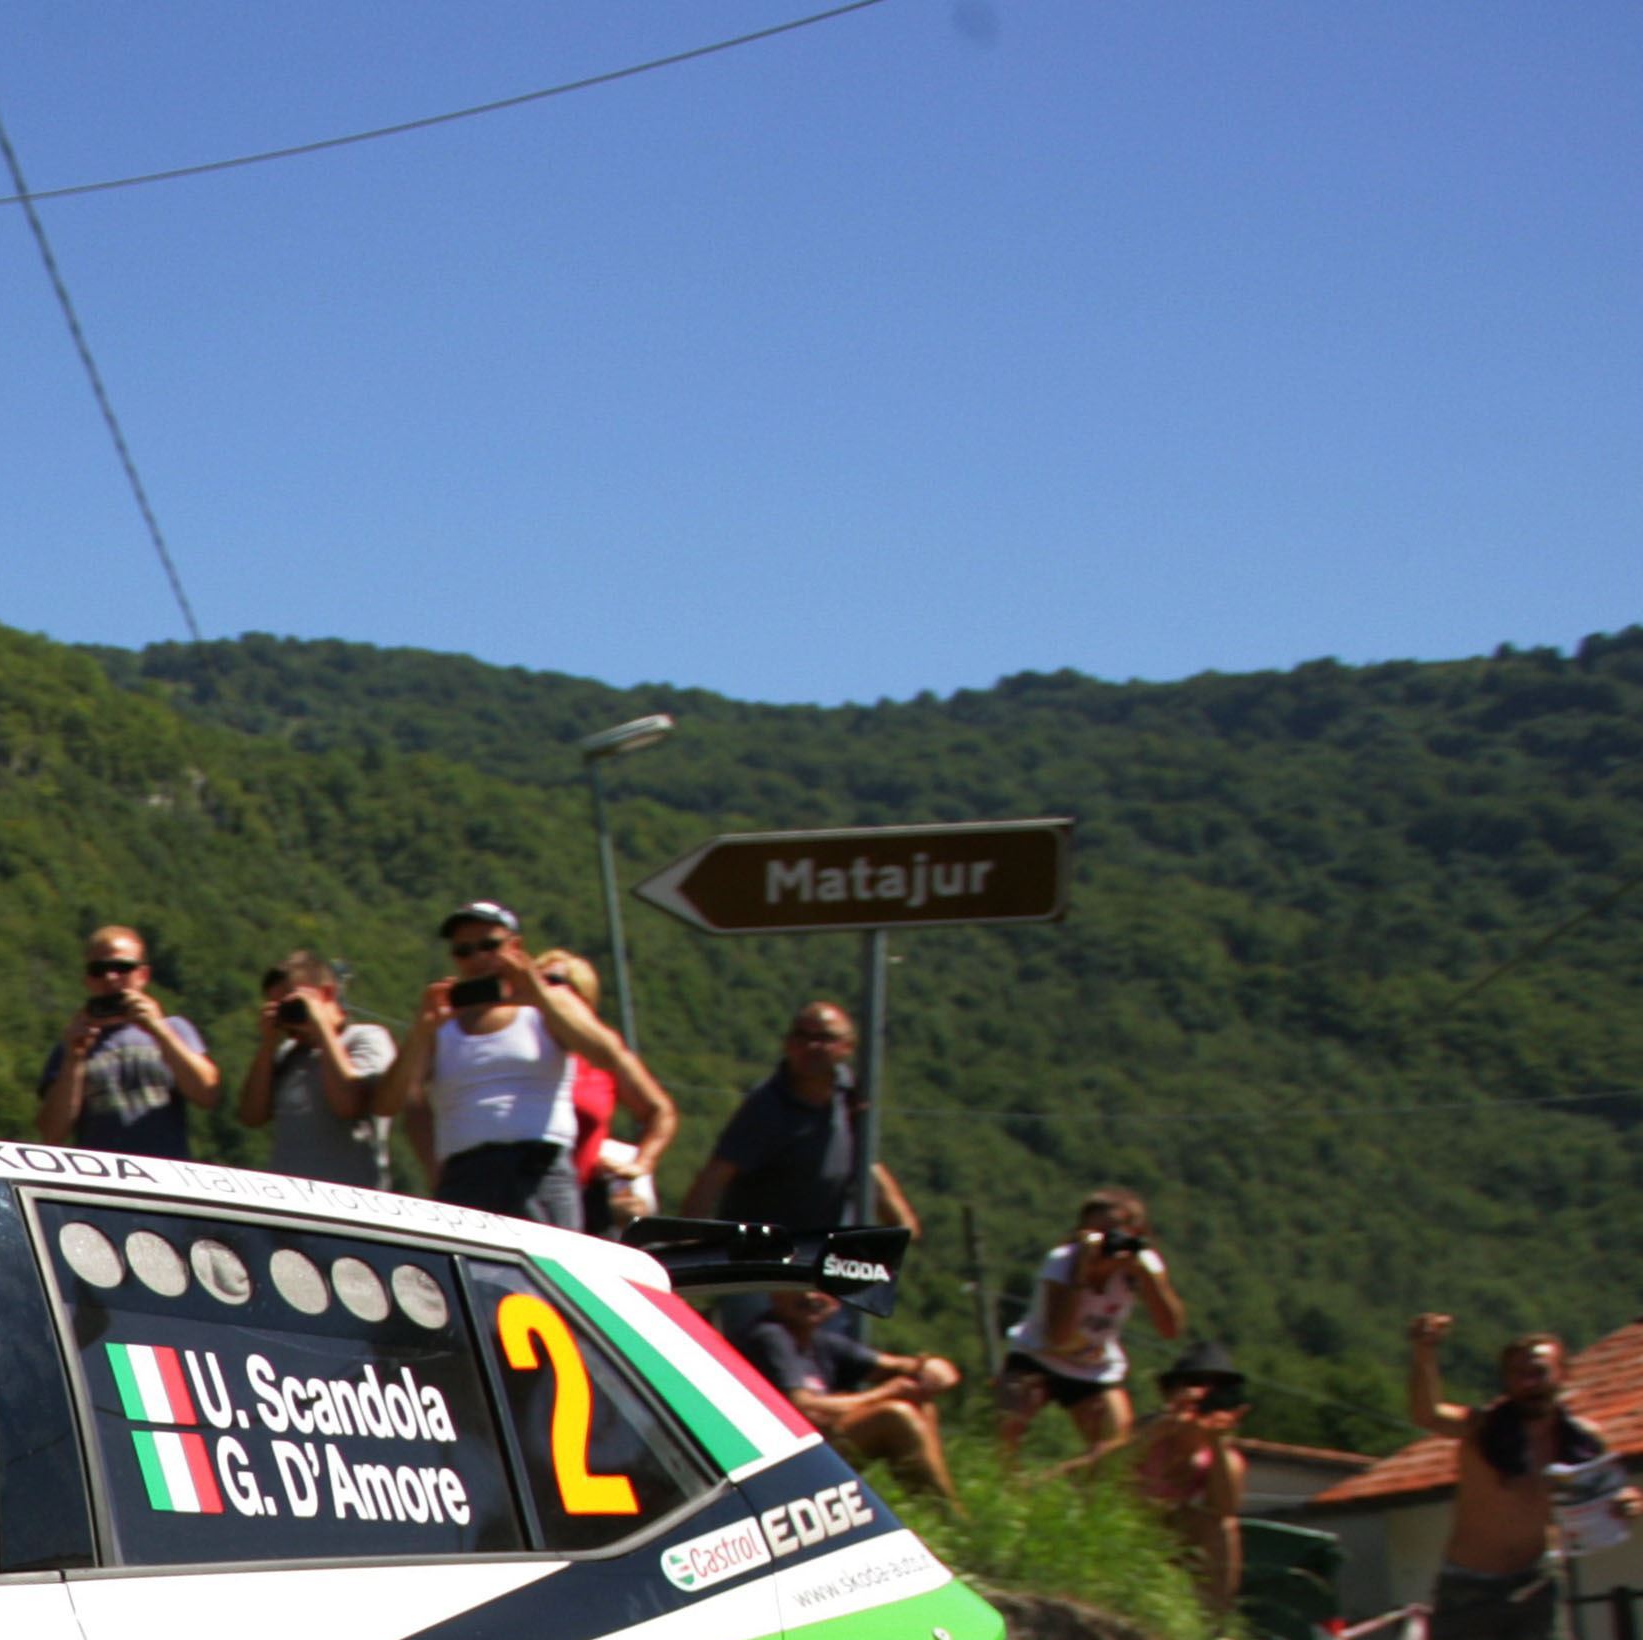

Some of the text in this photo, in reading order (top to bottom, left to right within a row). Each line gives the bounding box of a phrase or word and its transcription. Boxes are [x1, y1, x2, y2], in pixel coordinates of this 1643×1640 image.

[765, 853, 995, 908] Matajur
[169, 1161, 286, 1199] Italia
[822, 1250, 890, 1284] ŠKODA
[187, 1348, 456, 1444] U. Scandola
[497, 1294, 642, 1516] 2
[216, 1437, 277, 1516] G.
[689, 1481, 873, 1579] Castrol EDGE
